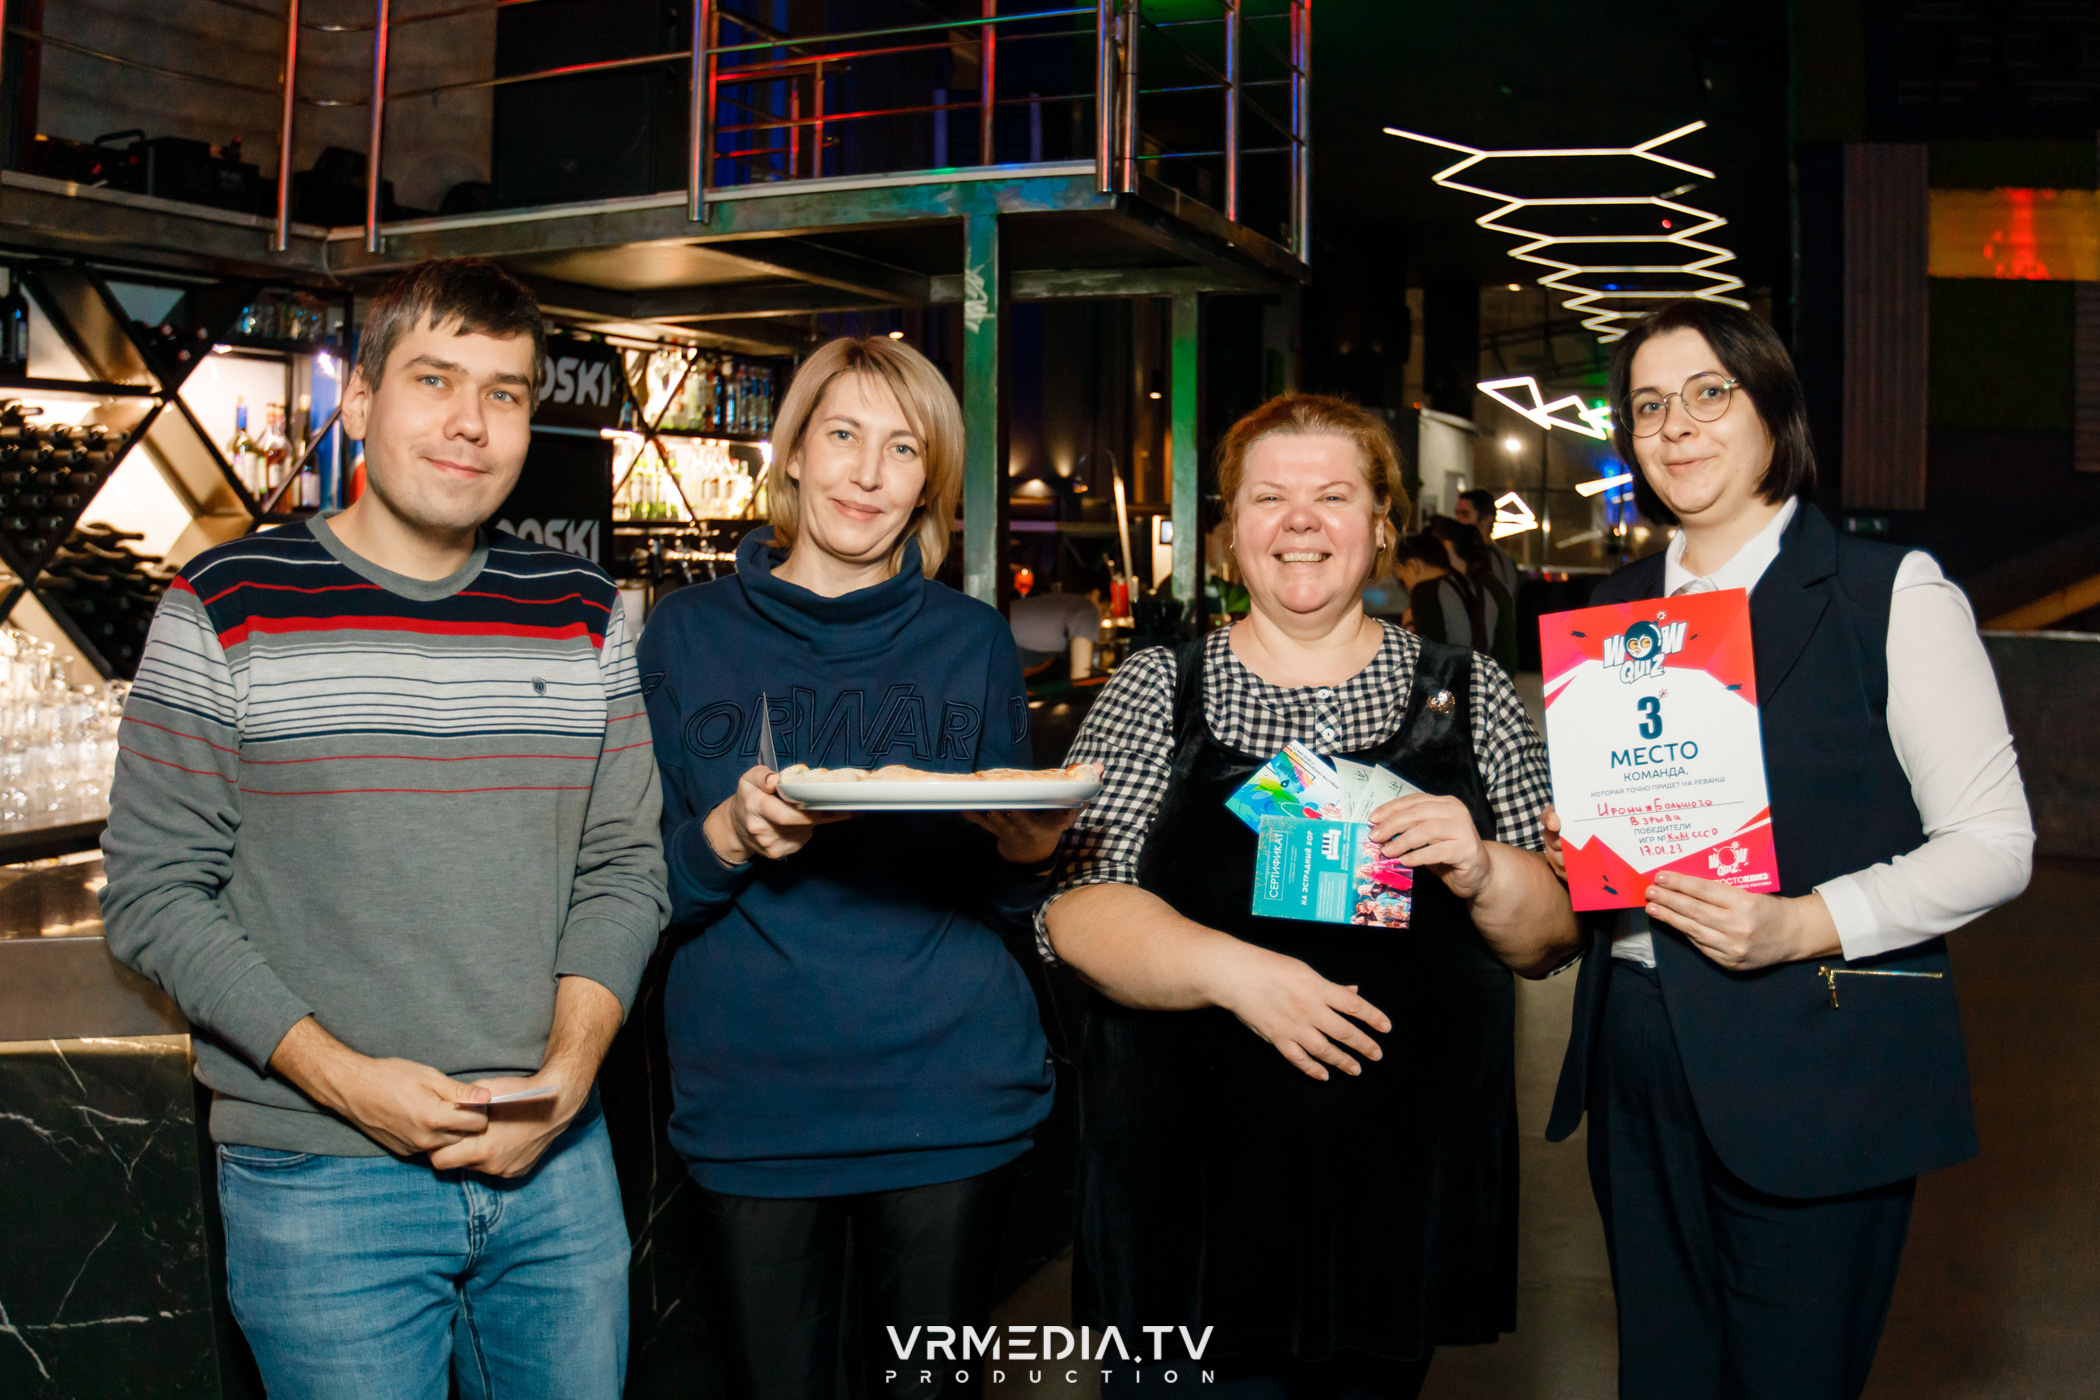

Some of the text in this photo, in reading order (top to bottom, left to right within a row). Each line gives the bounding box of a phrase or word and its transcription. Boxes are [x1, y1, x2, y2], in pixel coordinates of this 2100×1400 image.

[1603, 620, 1687, 669] WOW
[1620, 652, 1666, 685] QUIZ
[1637, 696, 1663, 740] 3
[1610, 740, 1698, 769] МЕСТО
[1590, 776, 1726, 798] КОТОРАЯ ТОЧНО ПРИДЕТ НА РЕВАНШ
[1623, 766, 1689, 783] КОМАНДА,
[1634, 823, 1691, 835] ПОБЕДИТЕЛИ
[1639, 835, 1655, 844] ИГР
[1640, 843, 1683, 857] 17.01.23
[1269, 832, 1284, 899] СЕРТИФИКАТ
[1301, 831, 1314, 906] НА ЭСТРАДНЫЙ ХОР
[1715, 873, 1768, 884] ОСТОКВИЗ
